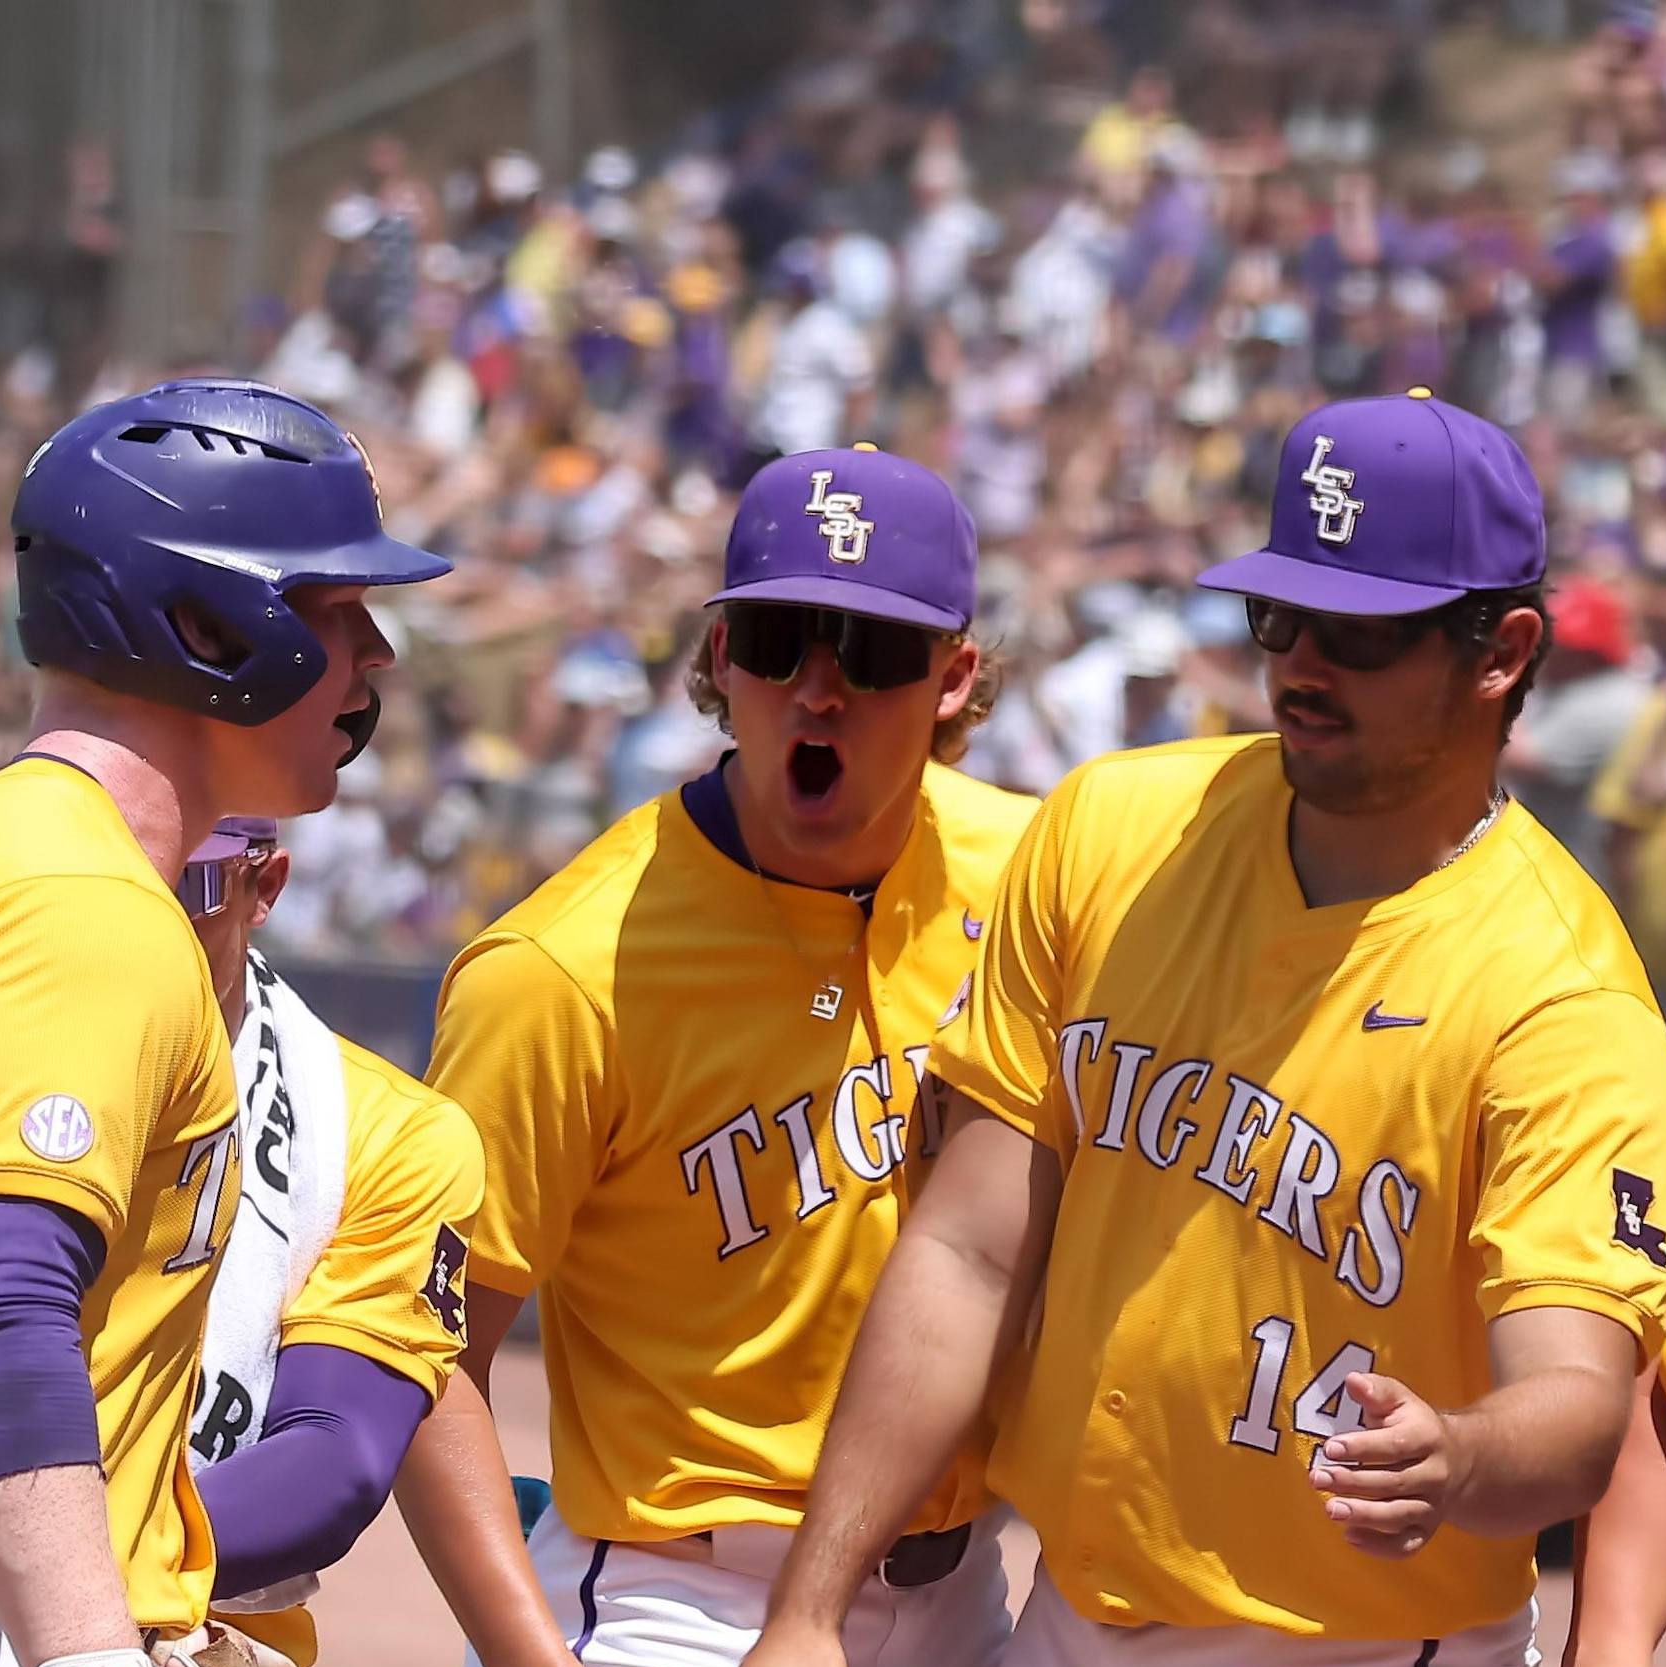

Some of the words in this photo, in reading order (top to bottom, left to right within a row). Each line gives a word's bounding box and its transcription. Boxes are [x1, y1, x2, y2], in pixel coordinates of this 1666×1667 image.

[804, 468, 875, 566] LSU
[1300, 434, 1365, 545] LSU
[223, 555, 283, 581] marucci
[23, 1094, 92, 1159] SEC
[1058, 1017, 1421, 1309] TIGERS
